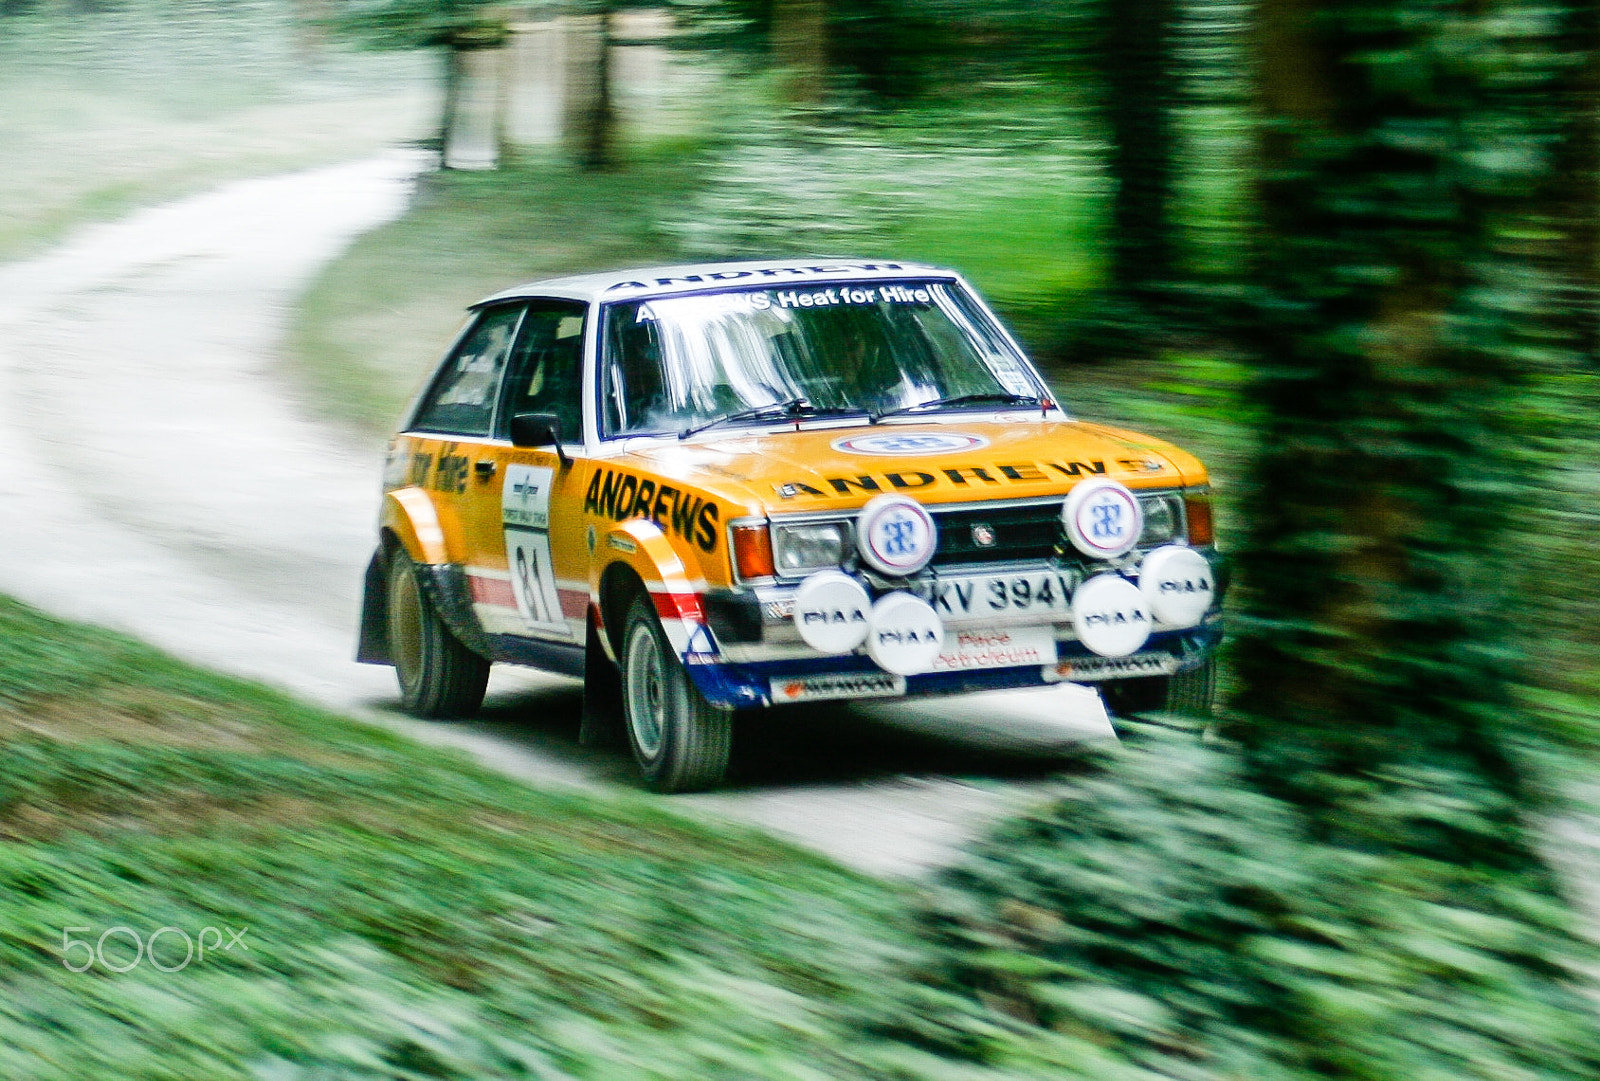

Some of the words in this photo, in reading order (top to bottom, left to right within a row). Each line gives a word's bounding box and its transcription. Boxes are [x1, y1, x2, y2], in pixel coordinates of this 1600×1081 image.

[604, 263, 940, 292] ANDREW
[777, 288, 839, 309] Heat
[840, 287, 876, 304] for
[879, 285, 930, 304] Hire
[584, 468, 719, 554] ANDREWS
[1160, 577, 1210, 594] PIAA
[804, 608, 867, 626] PIAA
[1085, 609, 1148, 628] PIAA
[878, 629, 939, 647] PIAA
